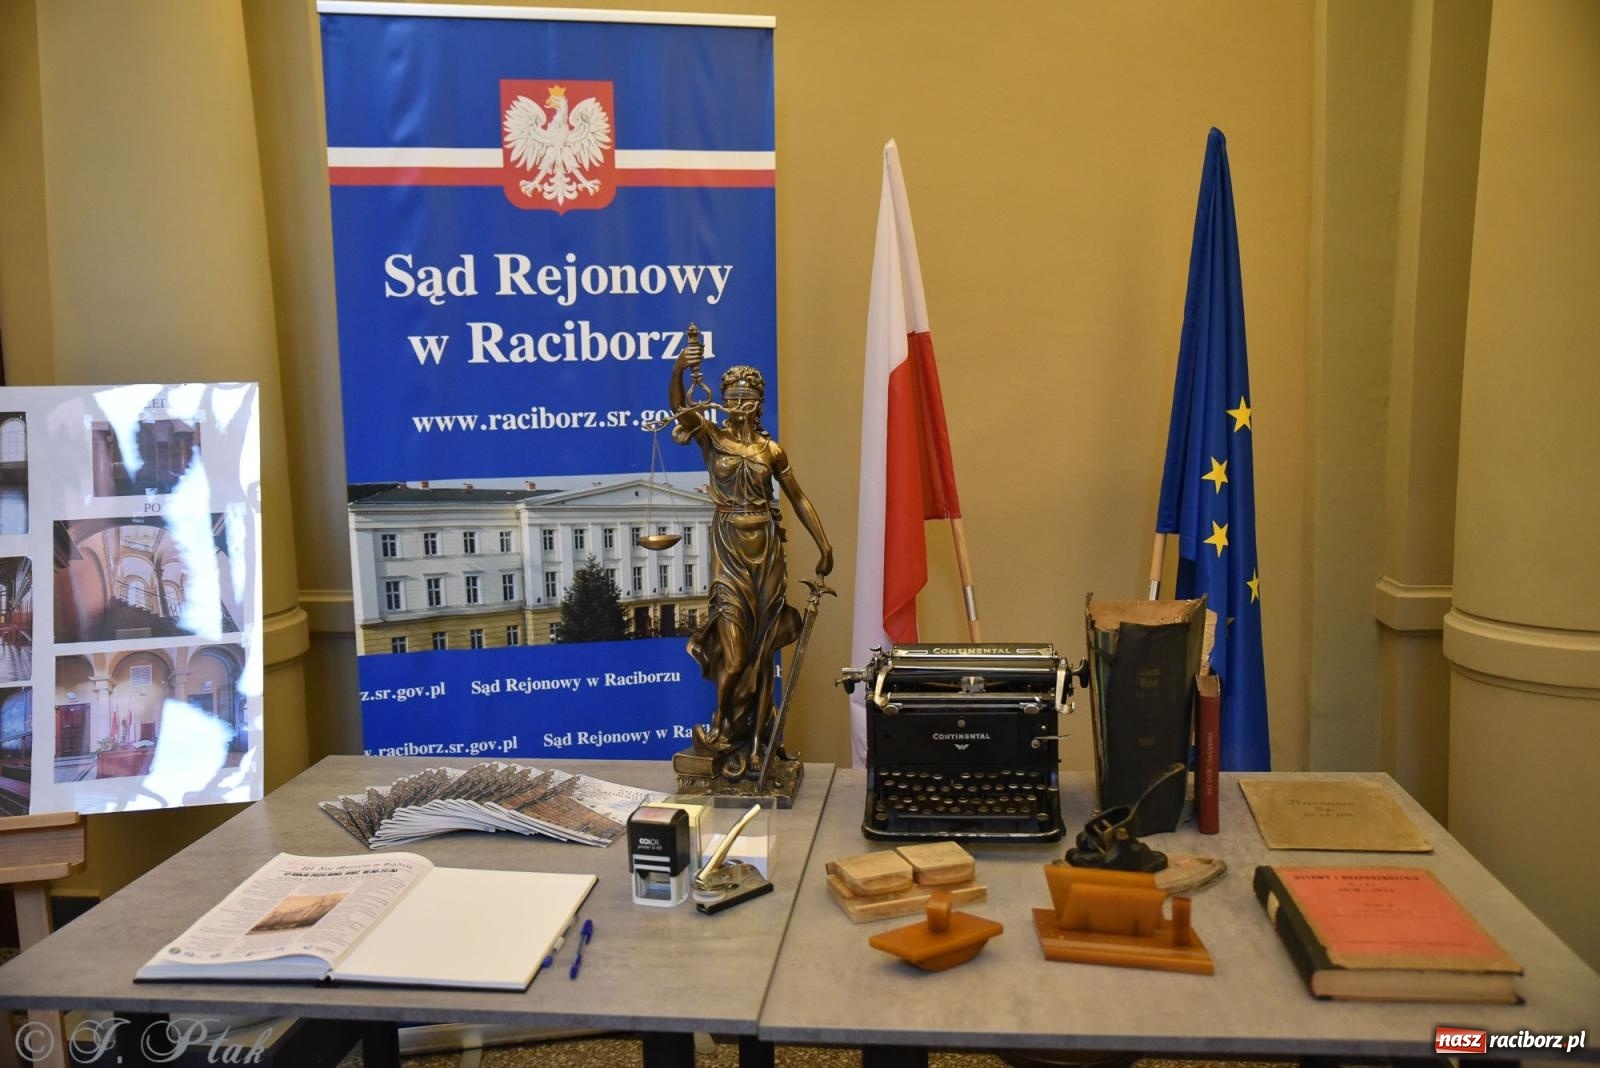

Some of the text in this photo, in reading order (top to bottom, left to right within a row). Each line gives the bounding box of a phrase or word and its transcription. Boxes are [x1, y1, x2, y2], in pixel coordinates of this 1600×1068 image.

[384, 252, 734, 306] Sąd Rejonowy
[407, 334, 450, 366] w
[471, 679, 501, 697] Sąd
[505, 676, 582, 695] Rejonowy
[586, 676, 600, 688] w
[604, 670, 681, 687] Raciborzu
[543, 732, 572, 749] Sąd
[577, 729, 651, 748] Rejonowy
[655, 728, 668, 740] w
[932, 732, 991, 741] CONTINENTAL
